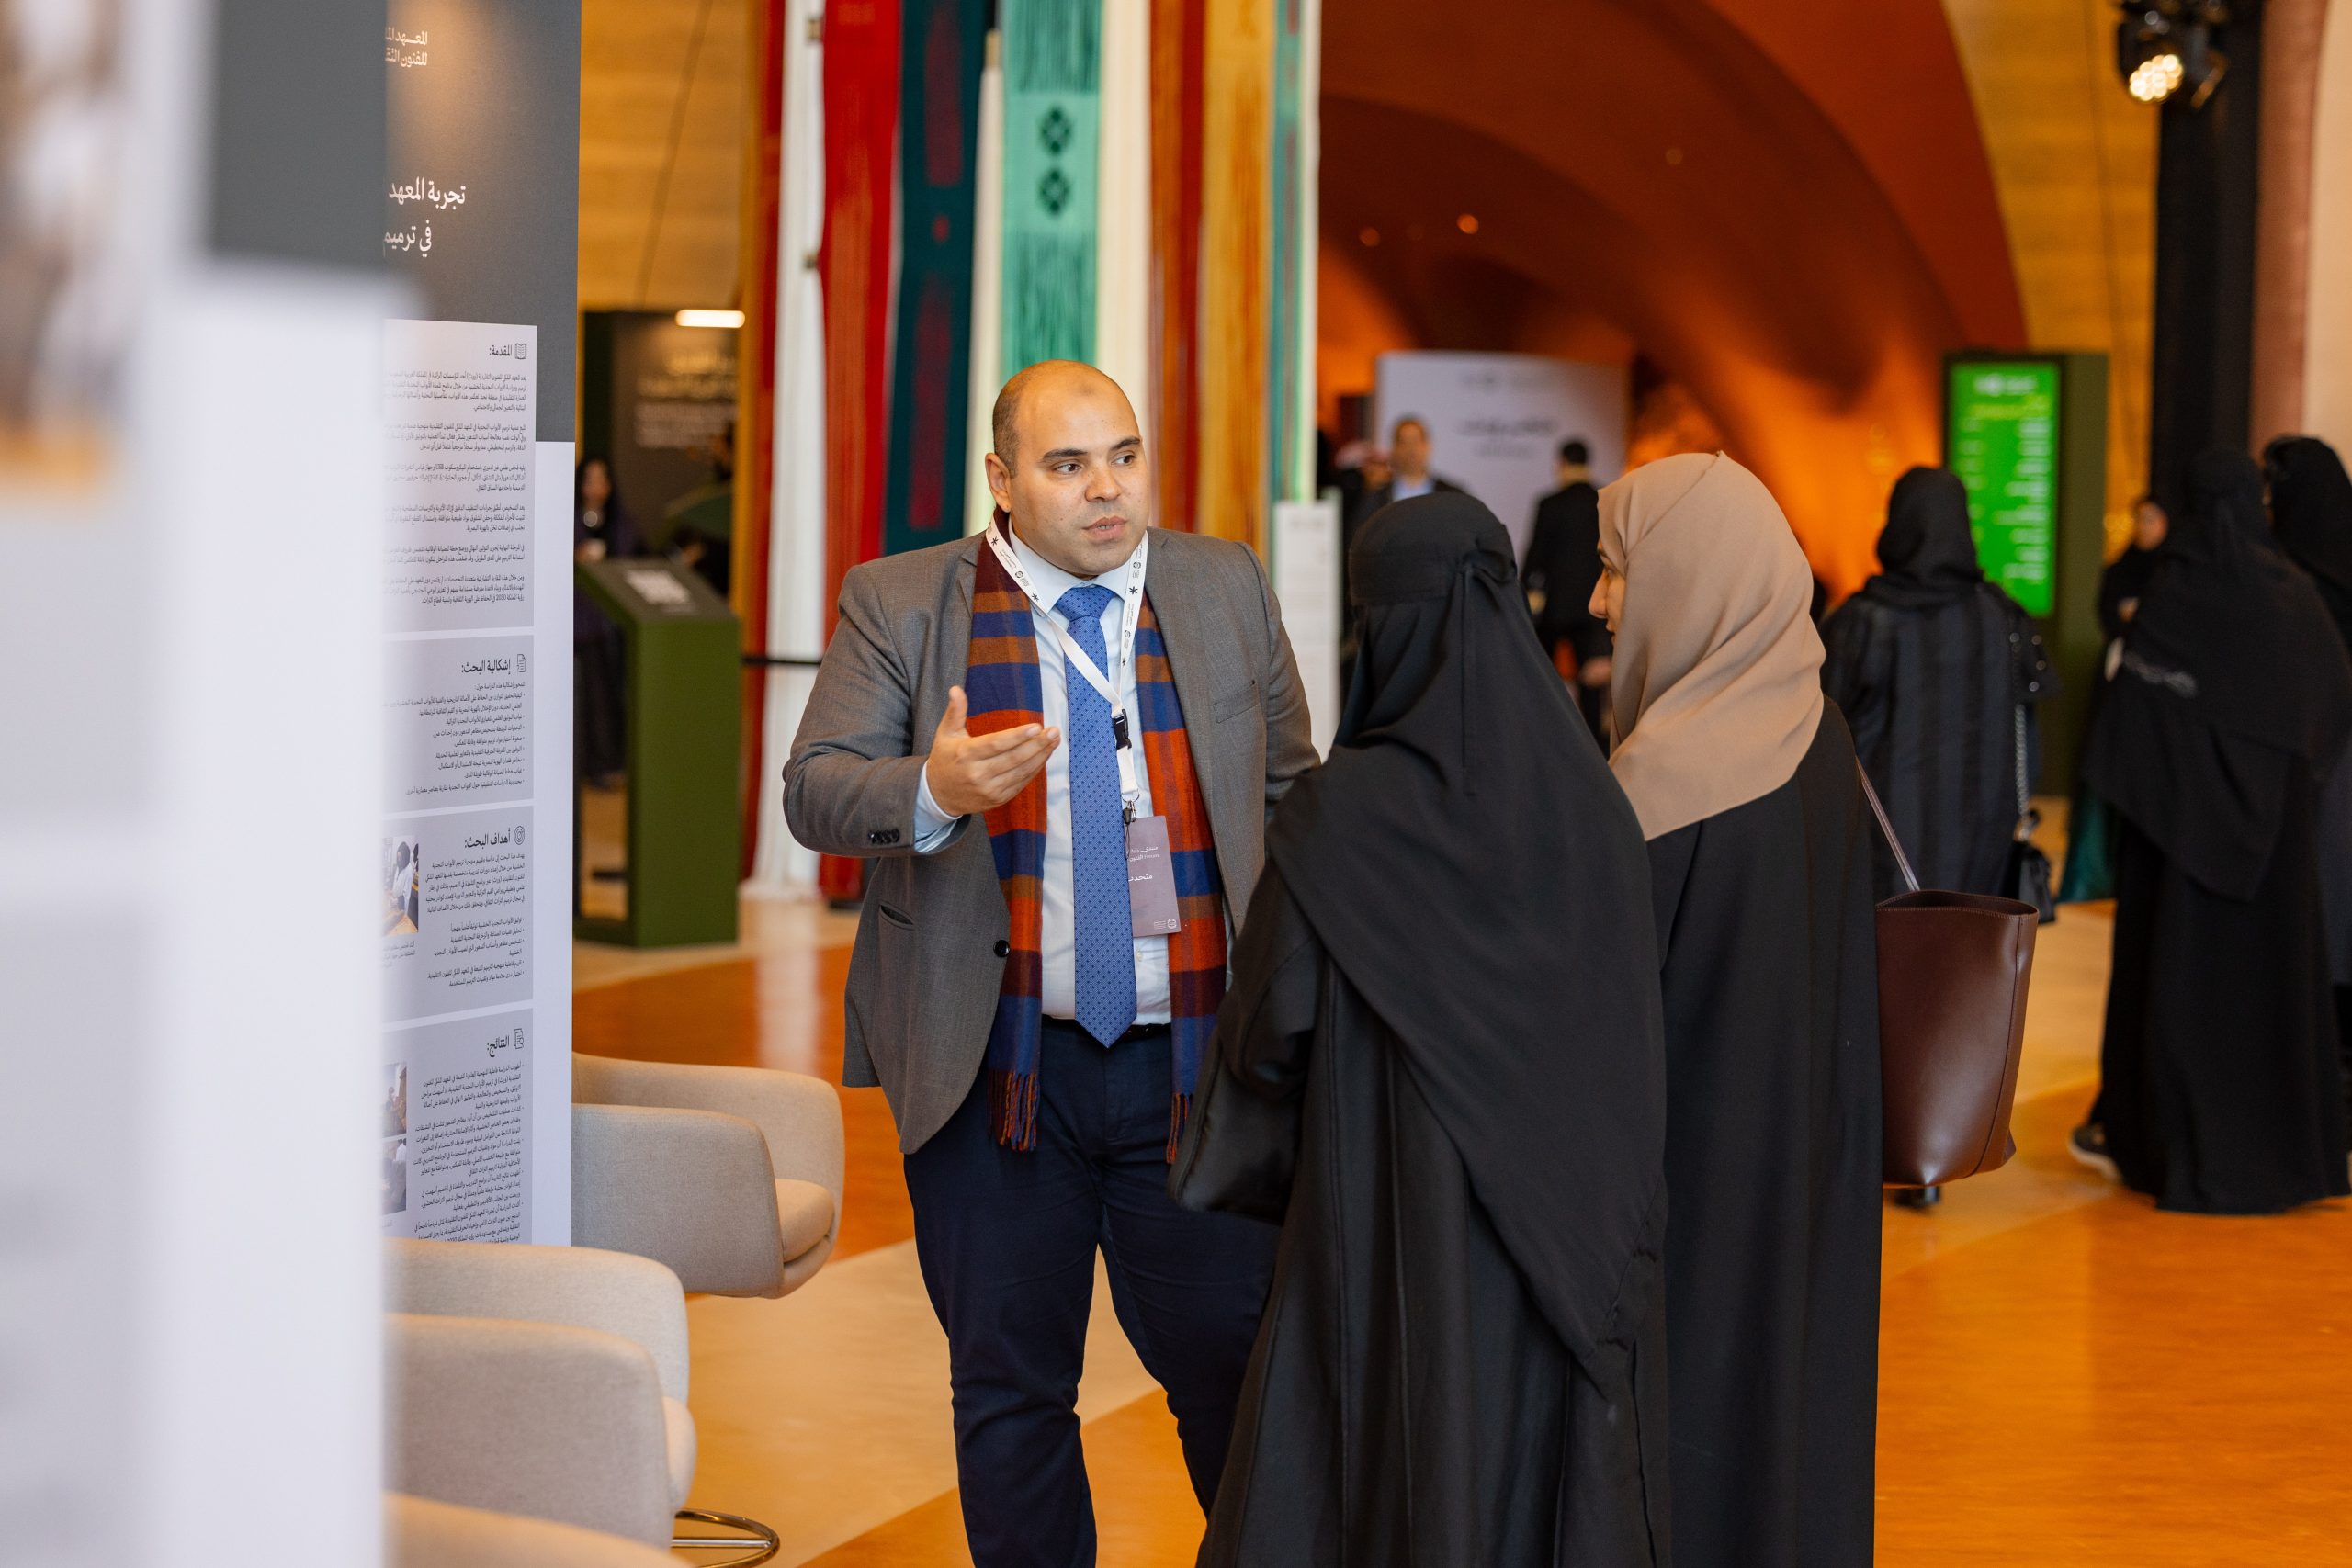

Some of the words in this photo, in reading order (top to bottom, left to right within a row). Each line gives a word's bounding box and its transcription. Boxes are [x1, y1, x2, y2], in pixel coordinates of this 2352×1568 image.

[401, 51, 427, 67] للفنون
[389, 176, 424, 205] المعهد
[427, 180, 466, 210] تجربة
[384, 225, 416, 254] ترميم
[419, 219, 432, 257] في
[461, 660, 486, 675] البحث:
[487, 659, 511, 675] إشكالية
[464, 833, 489, 850] البحث:
[491, 828, 511, 844] أهداف
[487, 1036, 510, 1057] النتائج:
